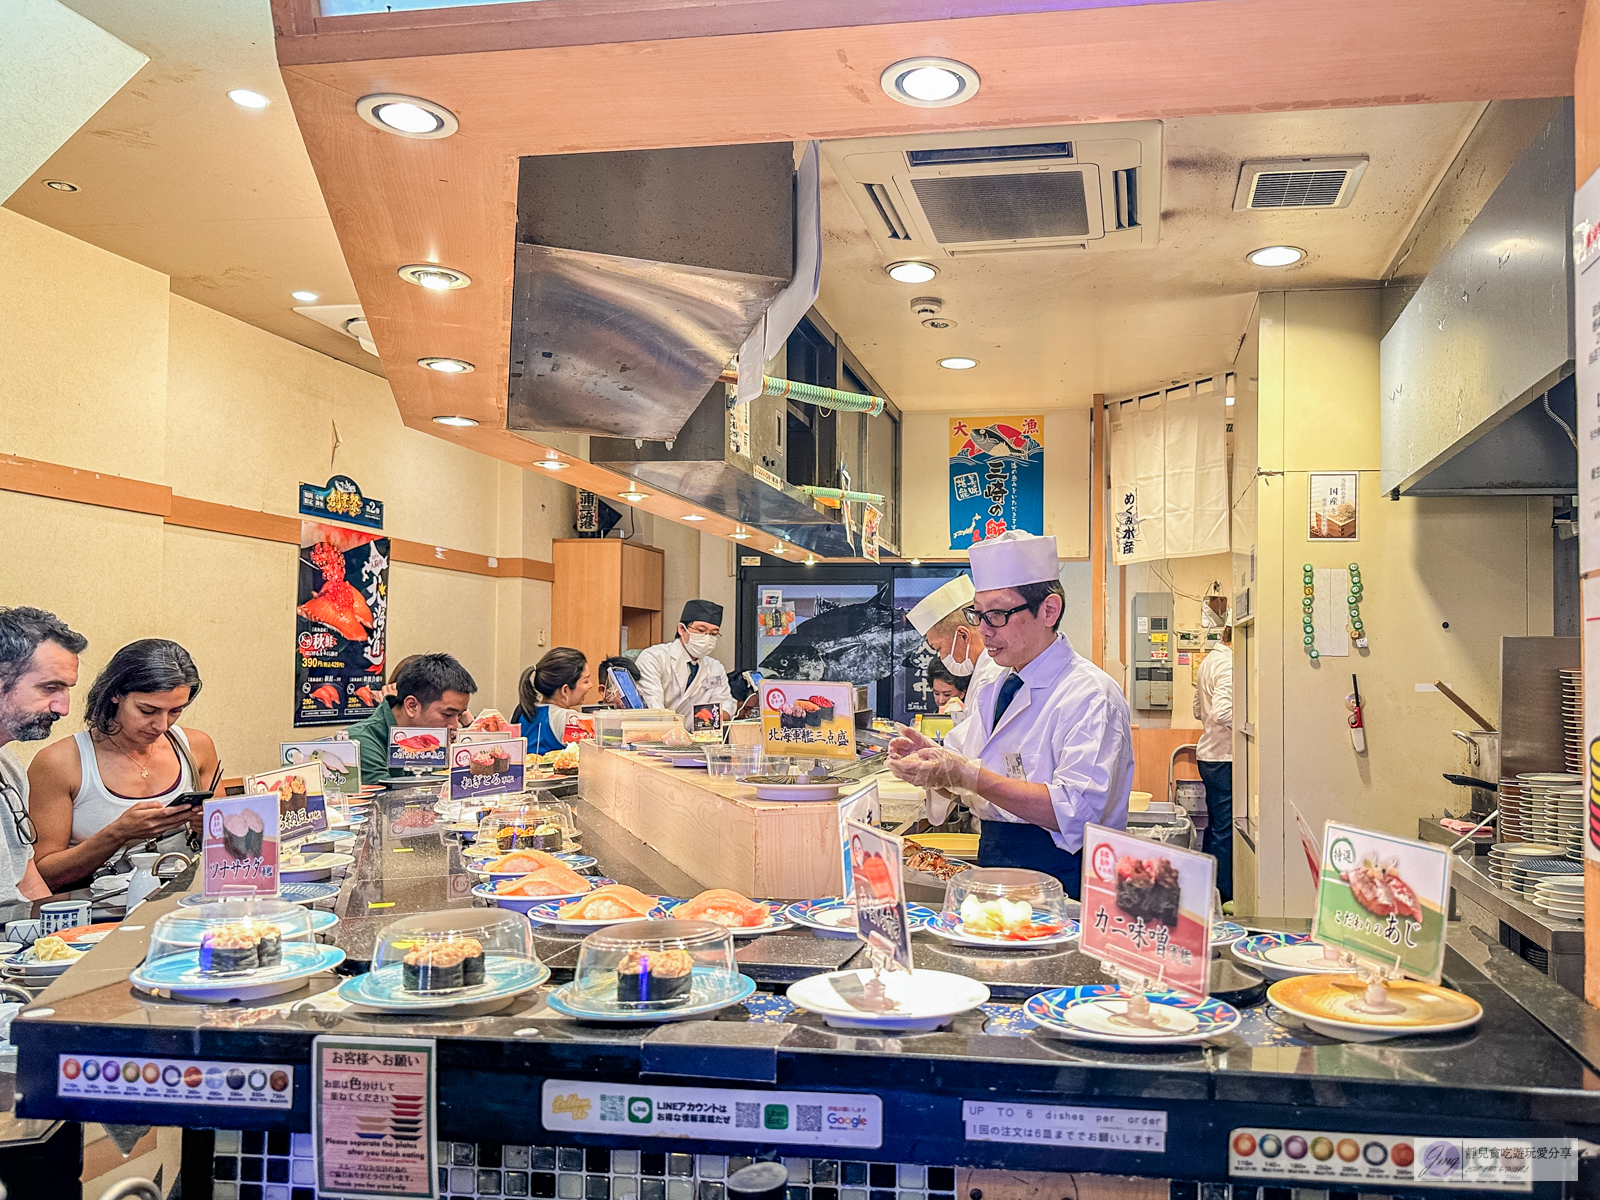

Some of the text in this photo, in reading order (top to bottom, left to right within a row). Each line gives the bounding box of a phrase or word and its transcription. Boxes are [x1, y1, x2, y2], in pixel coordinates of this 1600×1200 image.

[953, 419, 1039, 437] 大 漁
[579, 488, 595, 529] 浦三崎港
[768, 727, 849, 747] 北海軍艦三点盛
[1334, 909, 1422, 948] こだわりのあじ
[332, 1050, 420, 1067] お客様へお願い
[324, 1077, 395, 1091] お皿は色分けして
[330, 1092, 389, 1102] 重ねてください
[657, 1102, 727, 1113] LINEアカウントは
[657, 1113, 731, 1124] お得な情報満載だぜ
[827, 1112, 867, 1128] Google
[970, 1106, 1162, 1126] UP TO 6 dishes per order
[325, 1138, 348, 1146] Please
[350, 1140, 381, 1148] separate
[395, 1141, 417, 1149] plates
[381, 1149, 400, 1157] finish
[402, 1151, 425, 1160] eating
